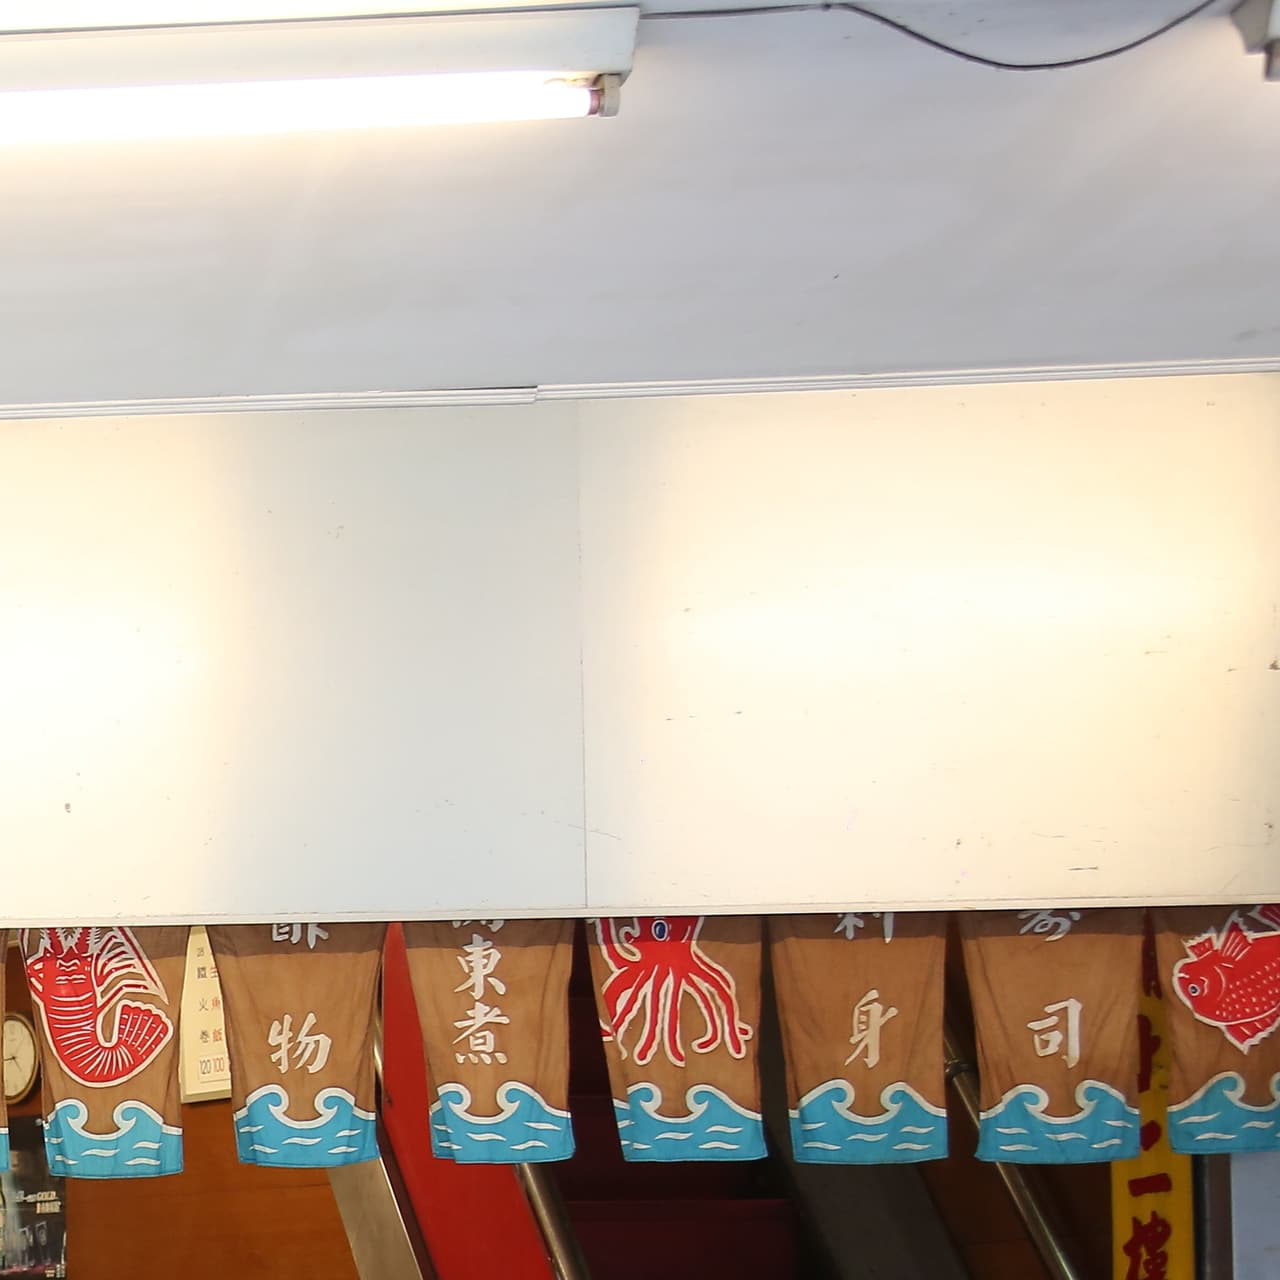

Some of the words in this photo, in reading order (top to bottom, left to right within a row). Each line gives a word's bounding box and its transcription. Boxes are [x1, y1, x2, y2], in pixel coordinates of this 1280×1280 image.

[452, 921, 510, 1064] 東煮
[200, 1060, 211, 1075] 120
[213, 1057, 225, 1072] 100
